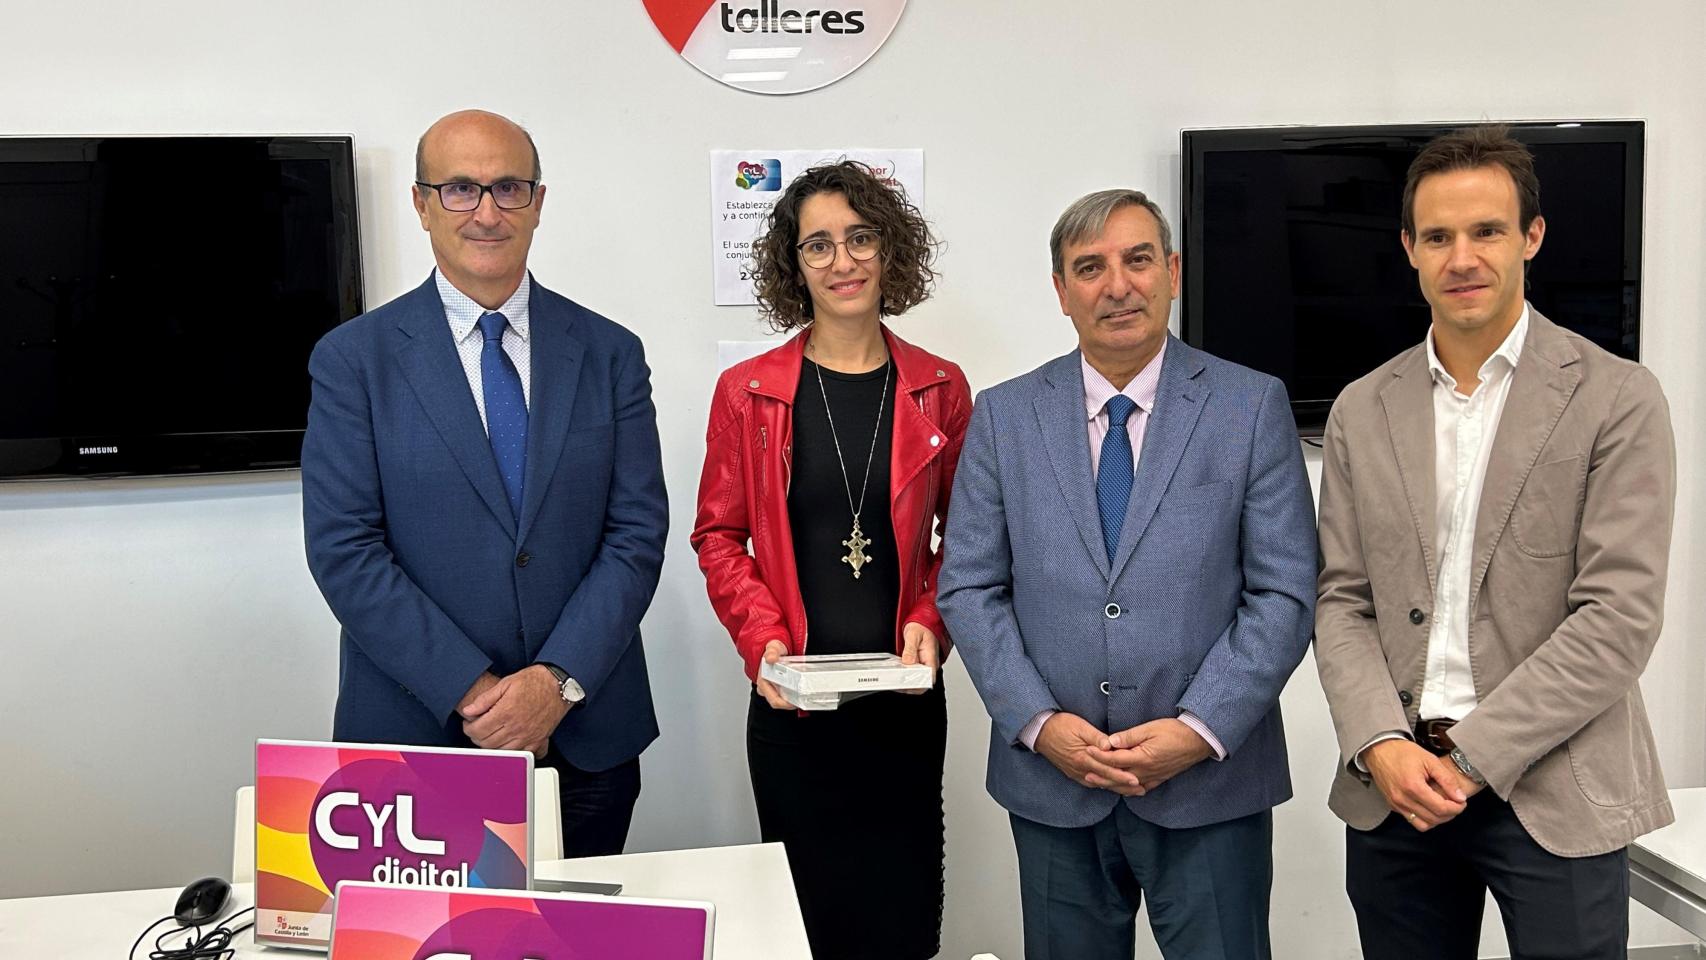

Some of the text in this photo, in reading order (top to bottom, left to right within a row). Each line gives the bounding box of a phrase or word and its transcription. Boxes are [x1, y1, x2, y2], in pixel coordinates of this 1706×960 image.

[720, 0, 865, 34] talleres
[726, 201, 773, 209] Establezca
[722, 213, 728, 221] y
[723, 241, 731, 249] El
[79, 446, 118, 455] SAMSUNG
